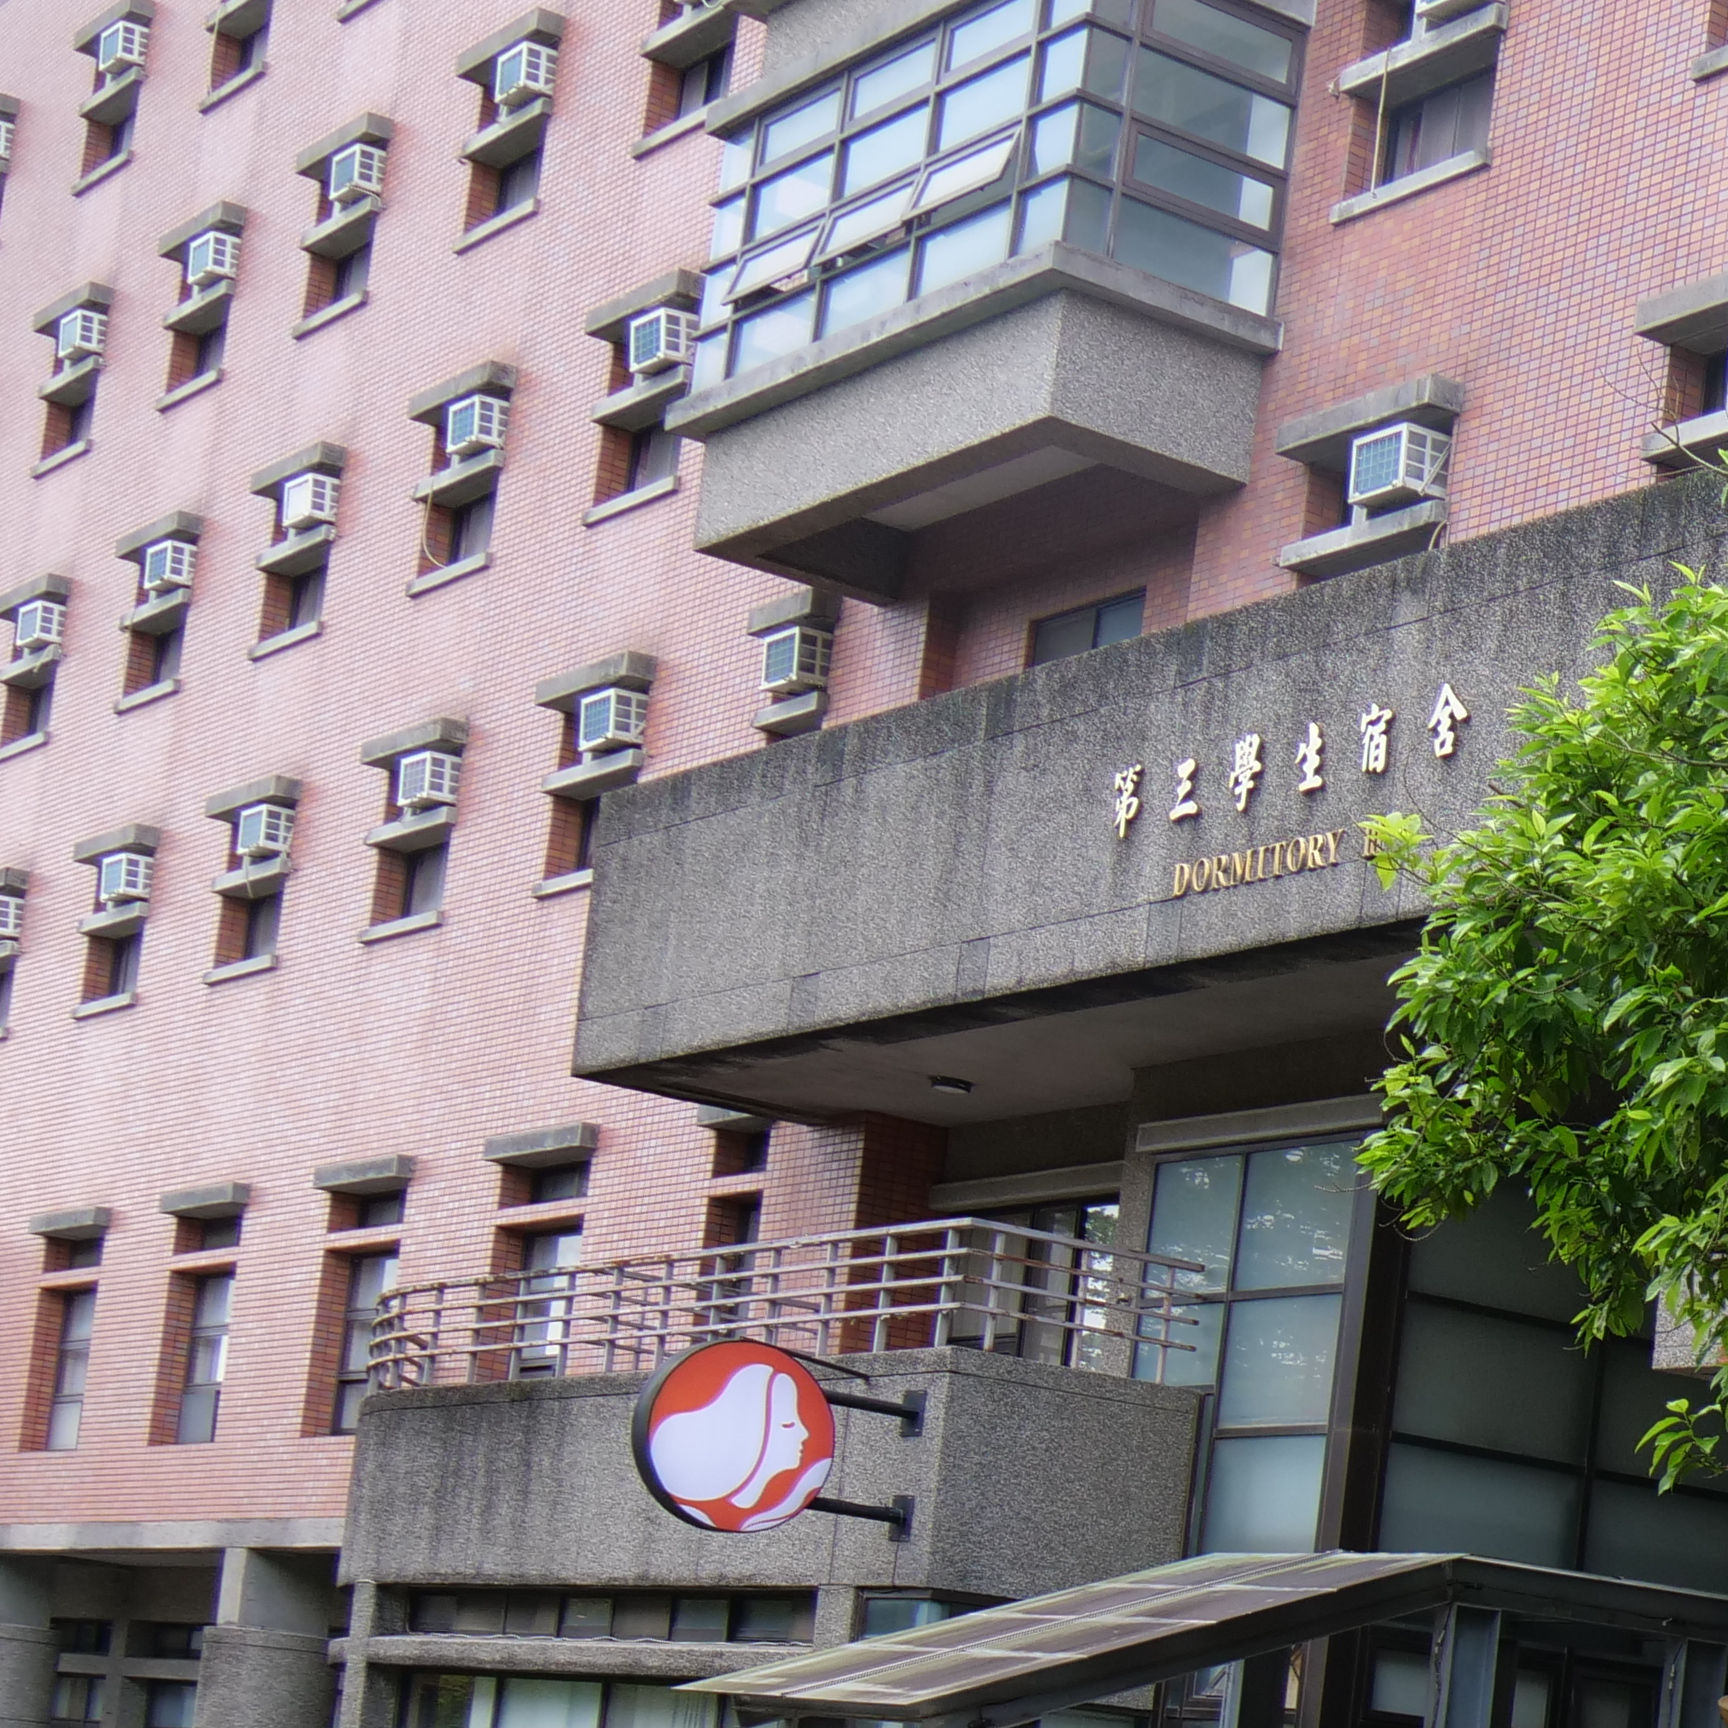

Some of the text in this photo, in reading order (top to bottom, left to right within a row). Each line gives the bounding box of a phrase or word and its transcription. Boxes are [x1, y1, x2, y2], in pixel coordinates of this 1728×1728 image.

[1114, 683, 1468, 838] 第三學生宿舍
[1173, 829, 1344, 896] DORMITORY
